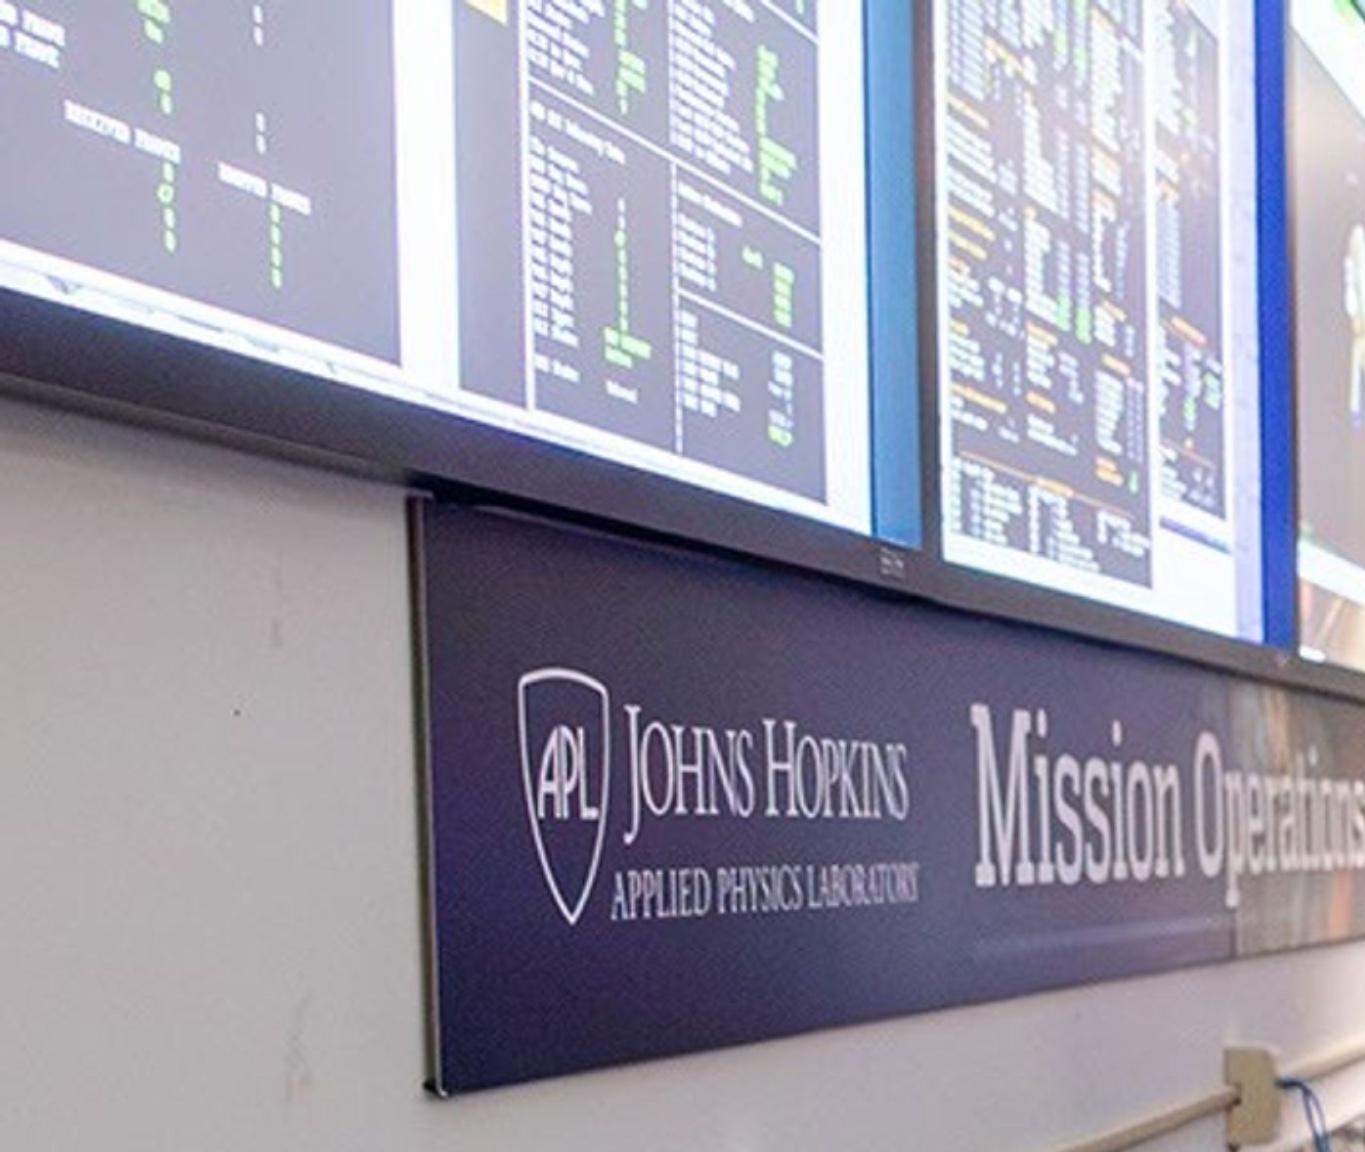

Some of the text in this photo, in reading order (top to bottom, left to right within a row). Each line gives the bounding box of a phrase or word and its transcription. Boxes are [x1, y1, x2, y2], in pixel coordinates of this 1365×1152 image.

[537, 724, 599, 820] APL
[622, 703, 910, 845] JOHNS HOPKINS
[970, 702, 1186, 888] Mission
[610, 861, 921, 922] APPLIED PHYSICS LABORATORY
